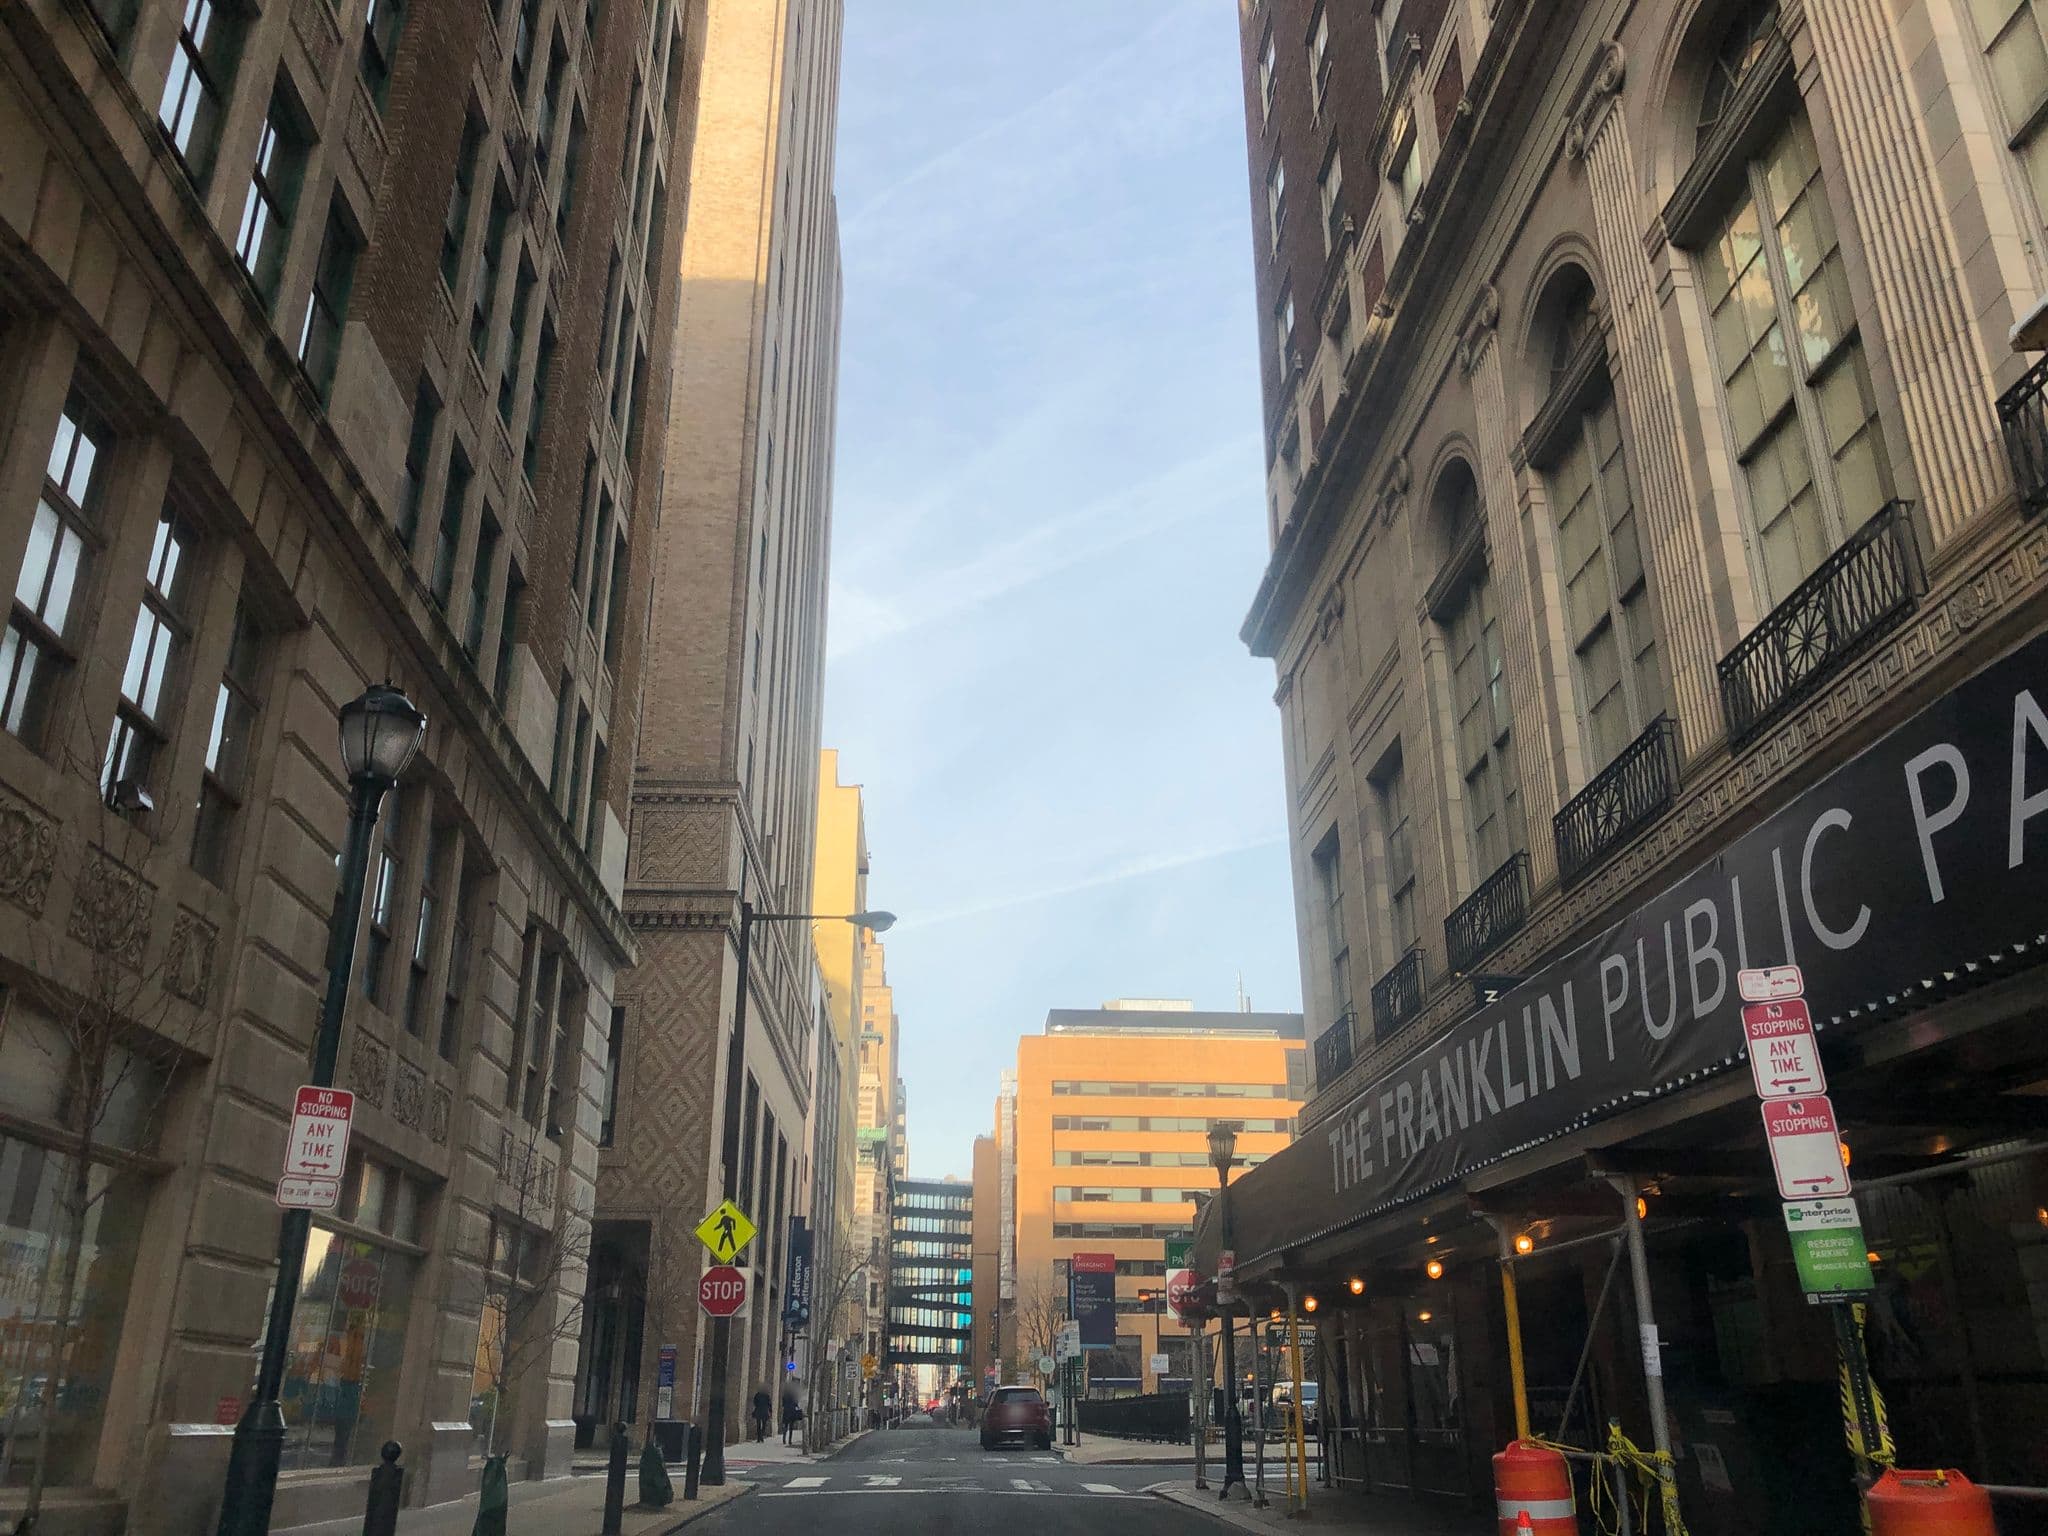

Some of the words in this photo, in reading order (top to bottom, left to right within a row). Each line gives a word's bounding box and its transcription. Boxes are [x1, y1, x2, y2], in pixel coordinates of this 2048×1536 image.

[1328, 1107, 1373, 1195] THE
[1379, 981, 1581, 1167] FRANKLIN
[1600, 808, 1871, 1061] PUBLIC
[1766, 1005, 1783, 1019] NO
[1751, 1018, 1805, 1036] STOPPING
[1769, 1040, 1796, 1057] ANY
[1770, 1057, 1804, 1074] TIME
[318, 1092, 334, 1104] NO
[300, 1102, 347, 1119] STOPPING
[1787, 1102, 1805, 1116] NO
[306, 1123, 335, 1138] ANY
[1772, 1115, 1829, 1134] STOPPING
[301, 1142, 335, 1158] TIME
[1807, 1237, 1854, 1249] RESERVED
[792, 1256, 802, 1297] Jefferson
[702, 1281, 743, 1300] STOP
[801, 1266, 810, 1305] Jefferson
[1171, 1285, 1200, 1303] STO
